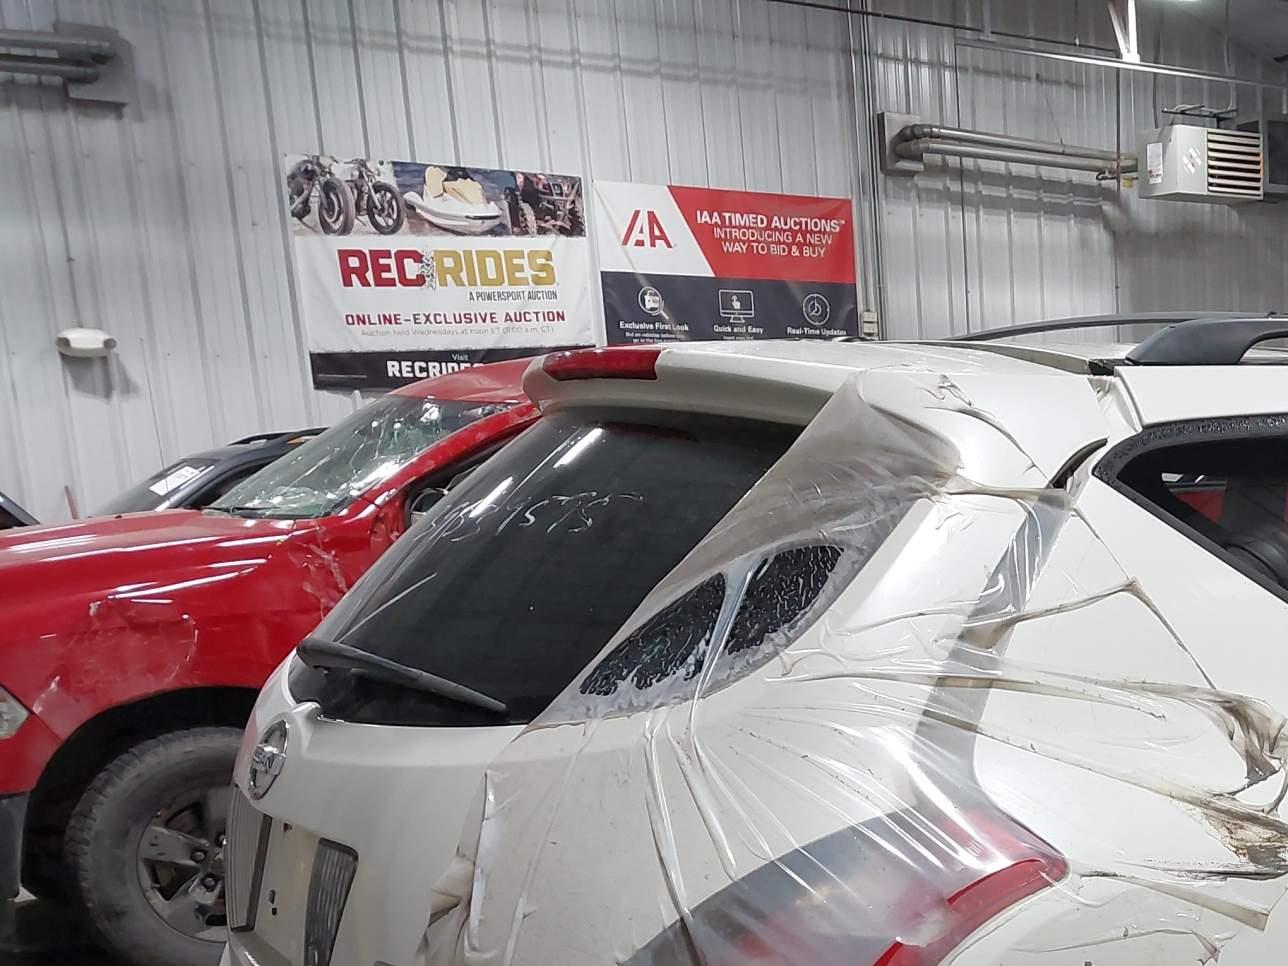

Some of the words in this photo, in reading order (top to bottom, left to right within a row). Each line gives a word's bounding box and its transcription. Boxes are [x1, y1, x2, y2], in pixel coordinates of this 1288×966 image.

[696, 210, 721, 225] IAA
[722, 212, 767, 228] TIMED
[713, 227, 792, 243] INTRODUCING
[796, 233, 804, 243] A
[806, 233, 832, 245] NEW
[722, 241, 748, 254] WAY
[751, 243, 767, 254] TO
[770, 244, 788, 256] BID
[791, 246, 800, 256] &
[802, 246, 825, 257] BUY
[433, 249, 557, 287] RIDES
[469, 291, 475, 301] A
[476, 290, 526, 301] POWERSPORT
[527, 290, 558, 300] AUCTION
[345, 311, 498, 326] ONLINE-EXCLUSIVE
[503, 310, 566, 323] AUCTION
[619, 320, 654, 330] Exclusive
[655, 321, 671, 330] First
[713, 324, 731, 333] Quick
[733, 325, 746, 333] and
[748, 326, 764, 335] Easy
[821, 327, 847, 337] Updates
[452, 353, 469, 361] Visit
[386, 360, 485, 378] RECRID
